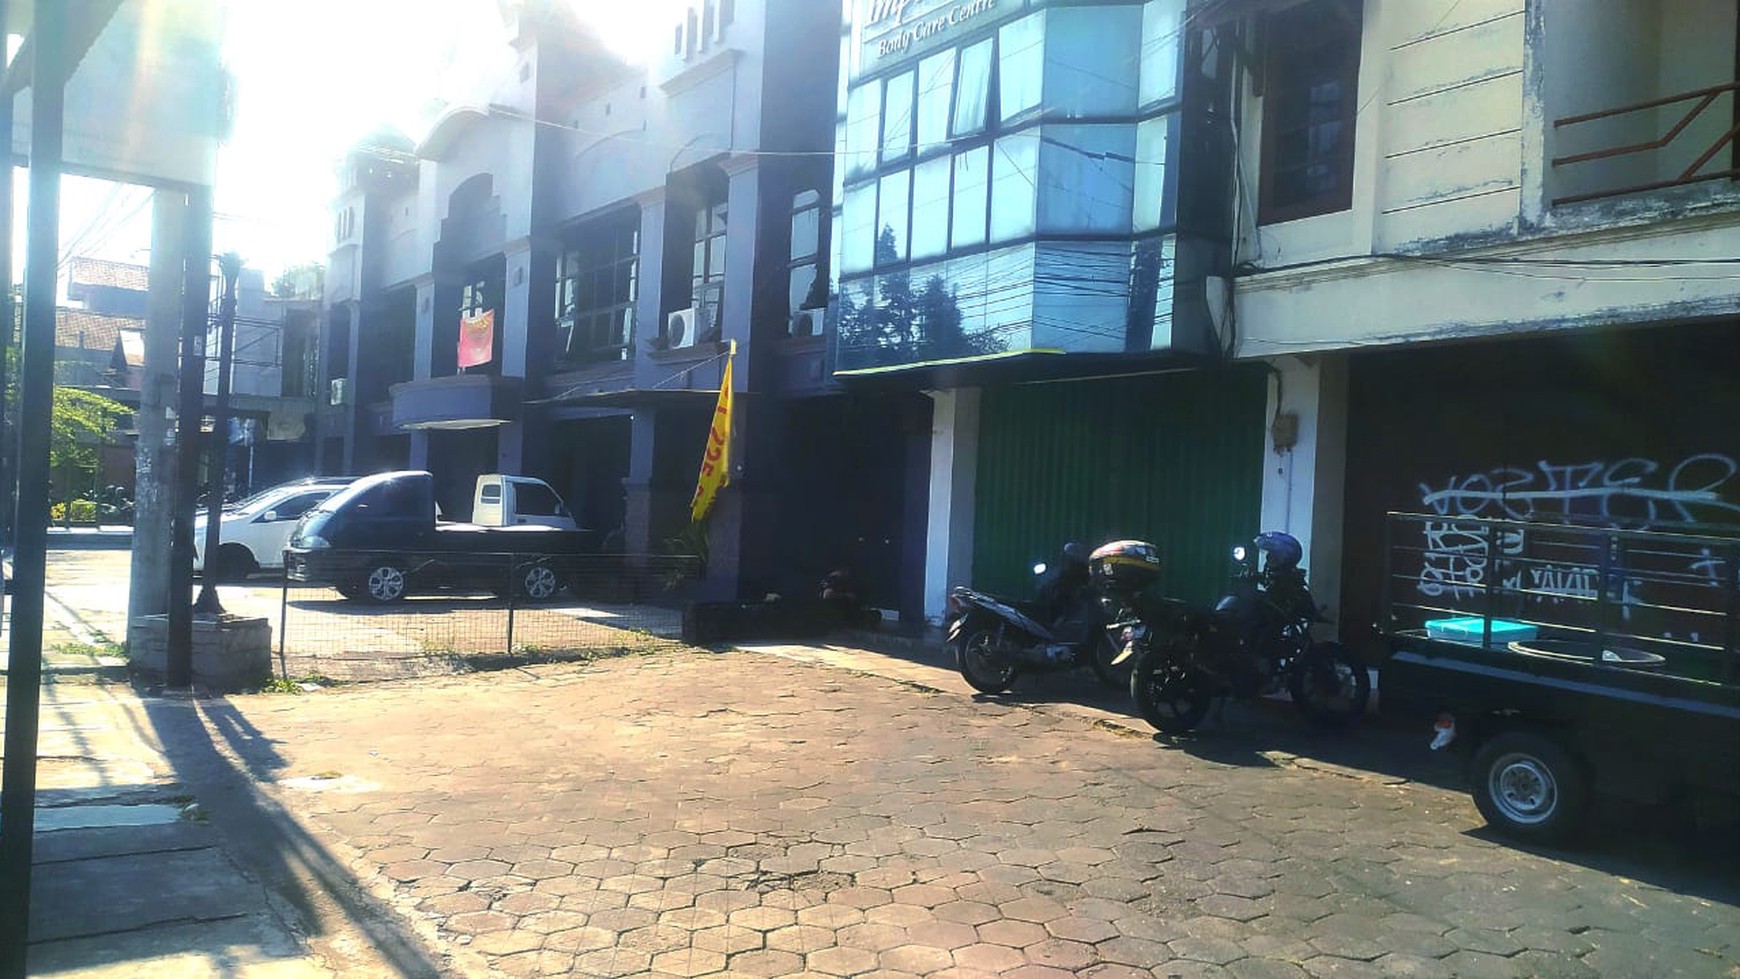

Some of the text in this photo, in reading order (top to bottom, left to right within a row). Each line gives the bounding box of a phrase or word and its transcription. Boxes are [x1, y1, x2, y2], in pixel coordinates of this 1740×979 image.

[878, 0, 996, 57] Body Care Centre
